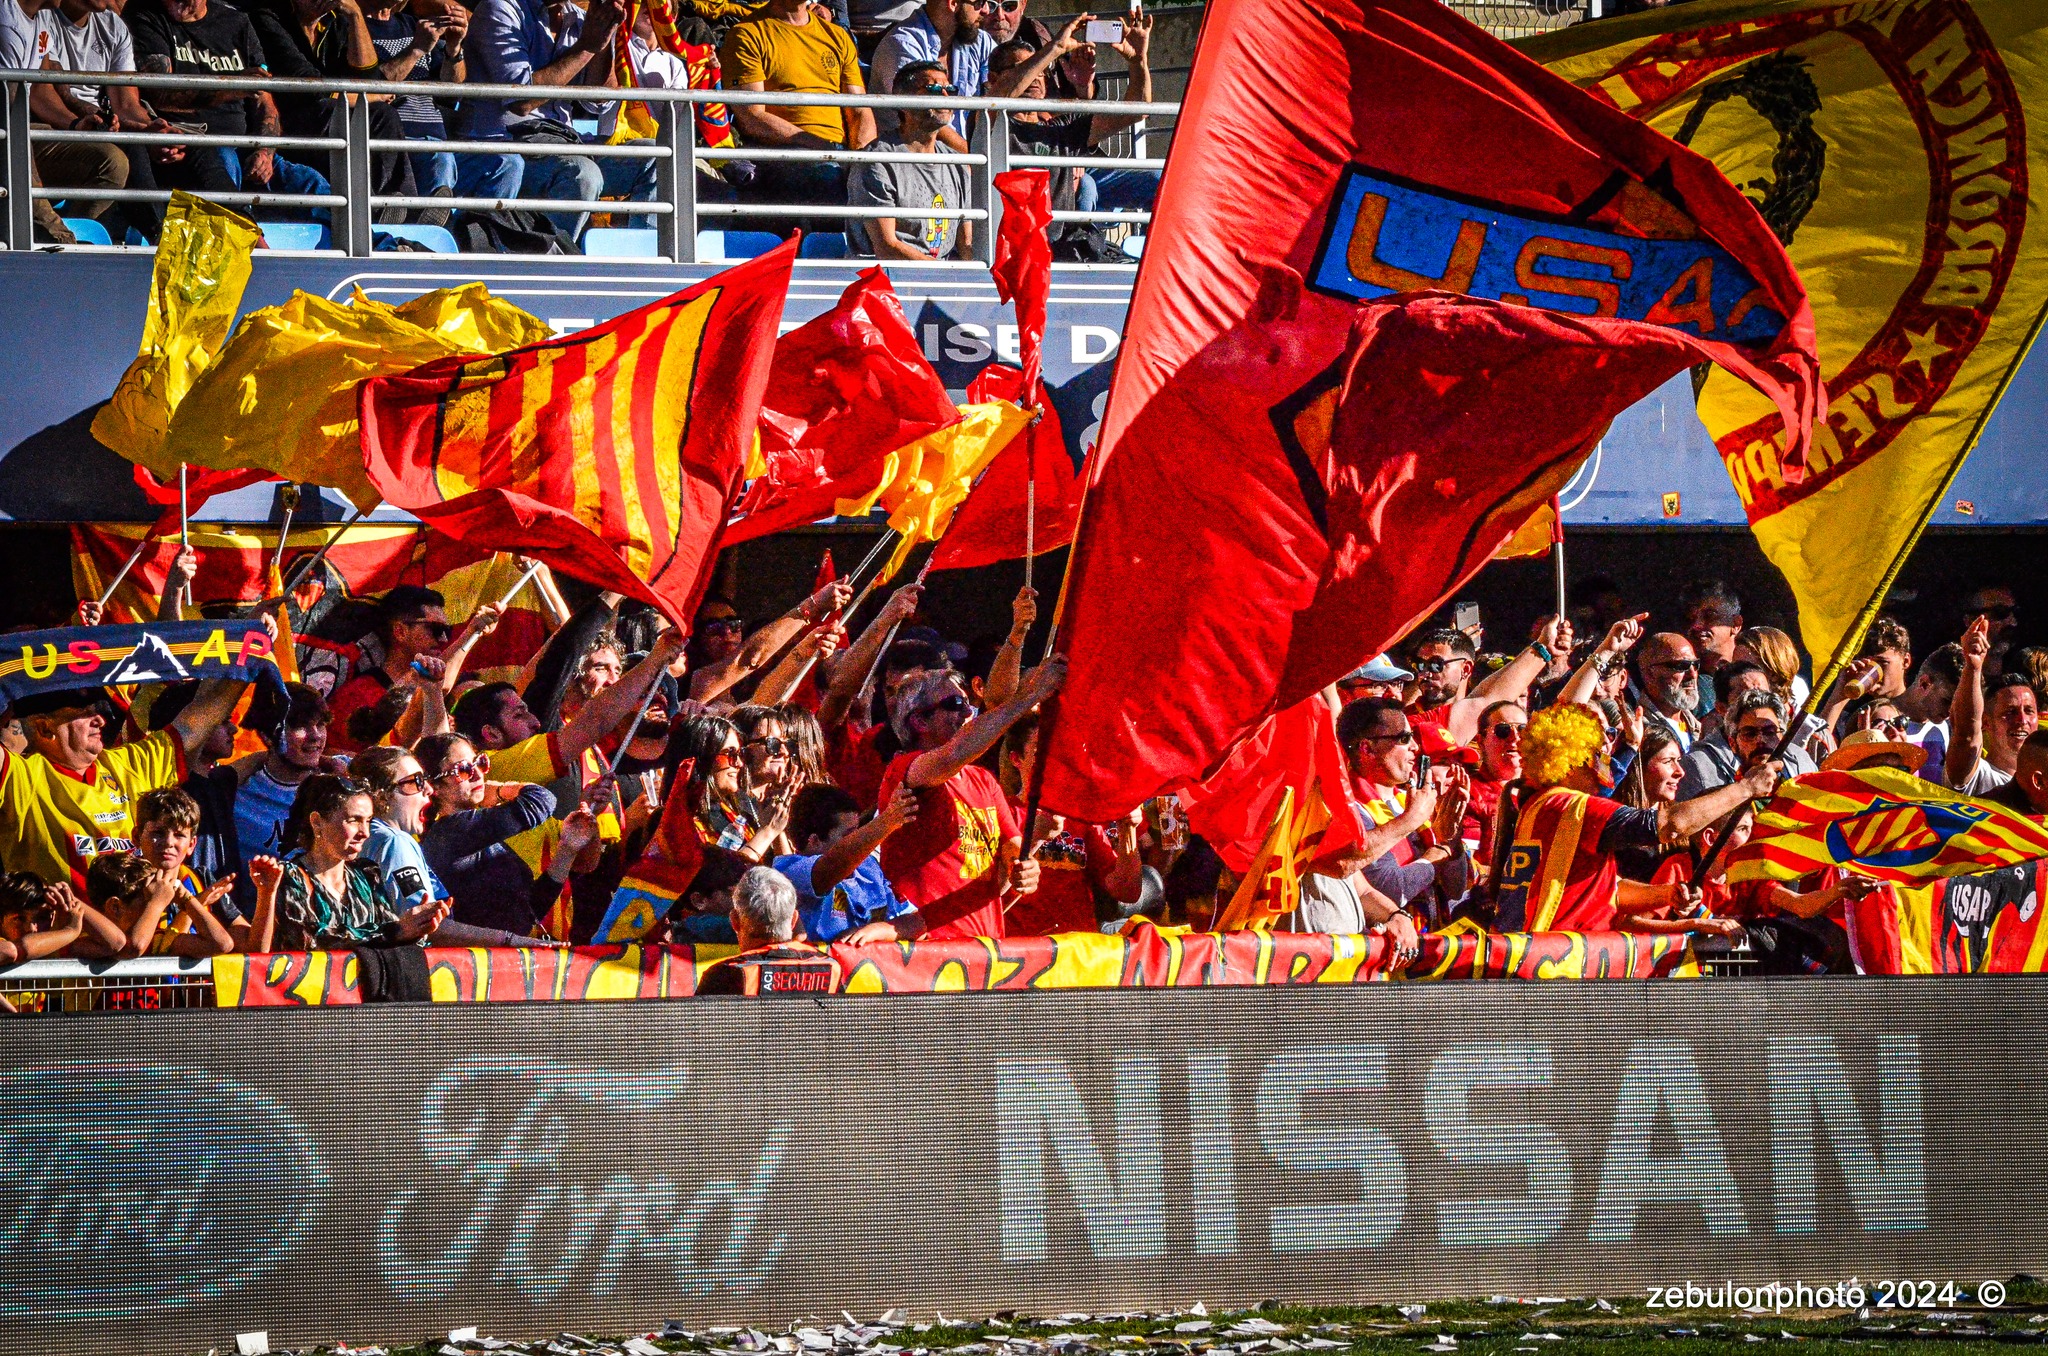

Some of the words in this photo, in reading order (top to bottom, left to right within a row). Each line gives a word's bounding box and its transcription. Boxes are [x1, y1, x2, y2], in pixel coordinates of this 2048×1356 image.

[1951, 884, 1992, 922] USAP
[763, 971, 774, 992] ACI
[773, 972, 830, 991] SECURITE
[995, 1033, 1928, 1262] NISSAN
[377, 1053, 793, 1301] Ford
